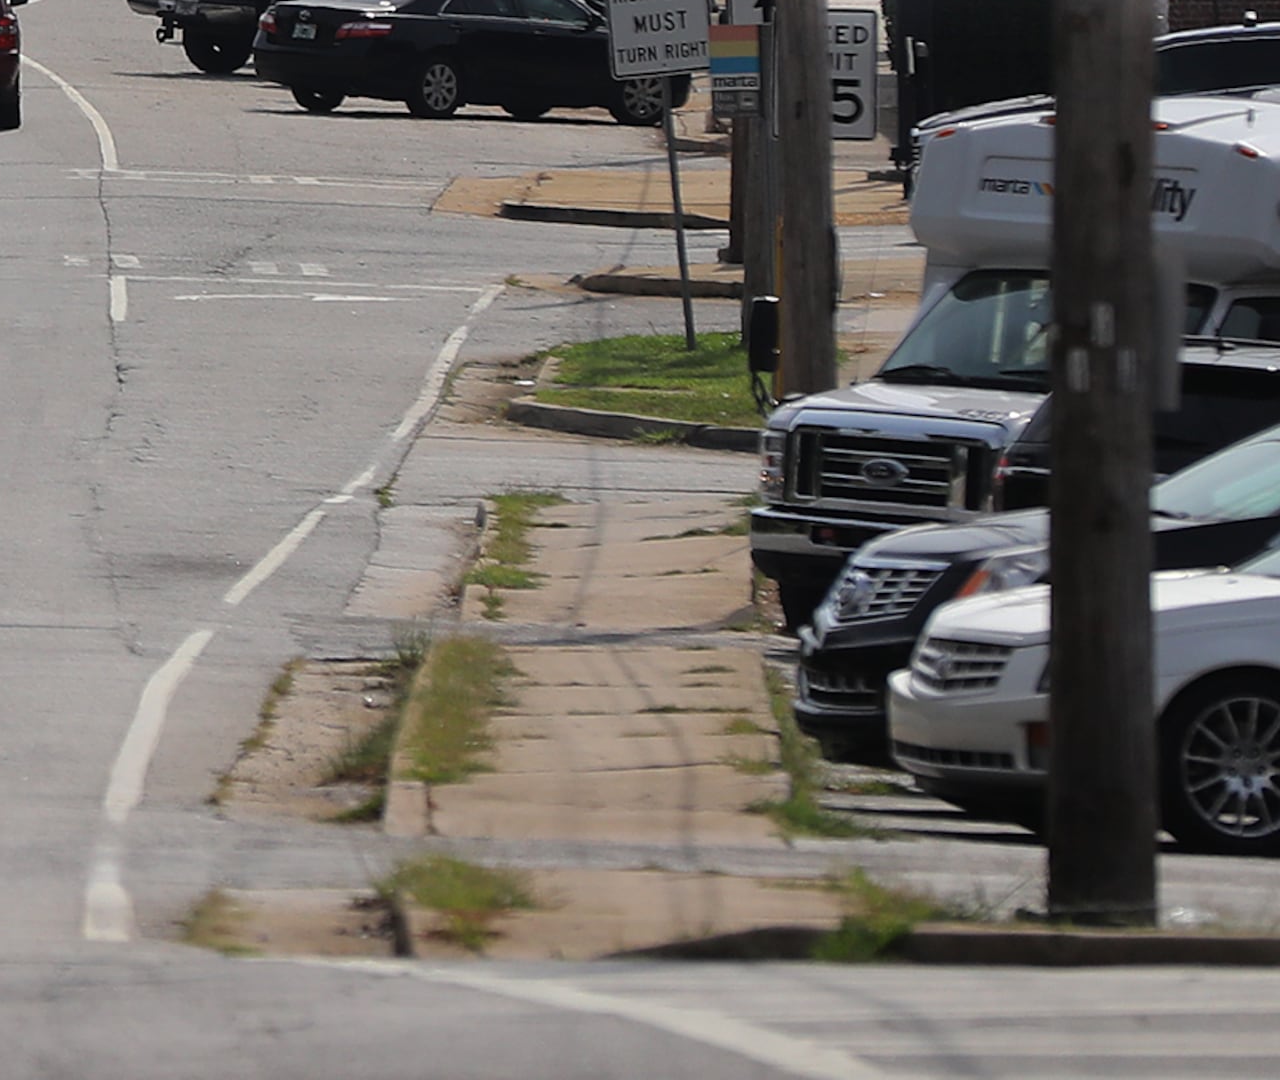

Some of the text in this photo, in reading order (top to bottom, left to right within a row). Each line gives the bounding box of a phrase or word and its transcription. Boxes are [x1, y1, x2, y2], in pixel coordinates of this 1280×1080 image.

[634, 10, 688, 34] MUST
[617, 40, 708, 64] TURN RIGHT
[713, 76, 759, 88] marta
[979, 176, 1032, 195] marta
